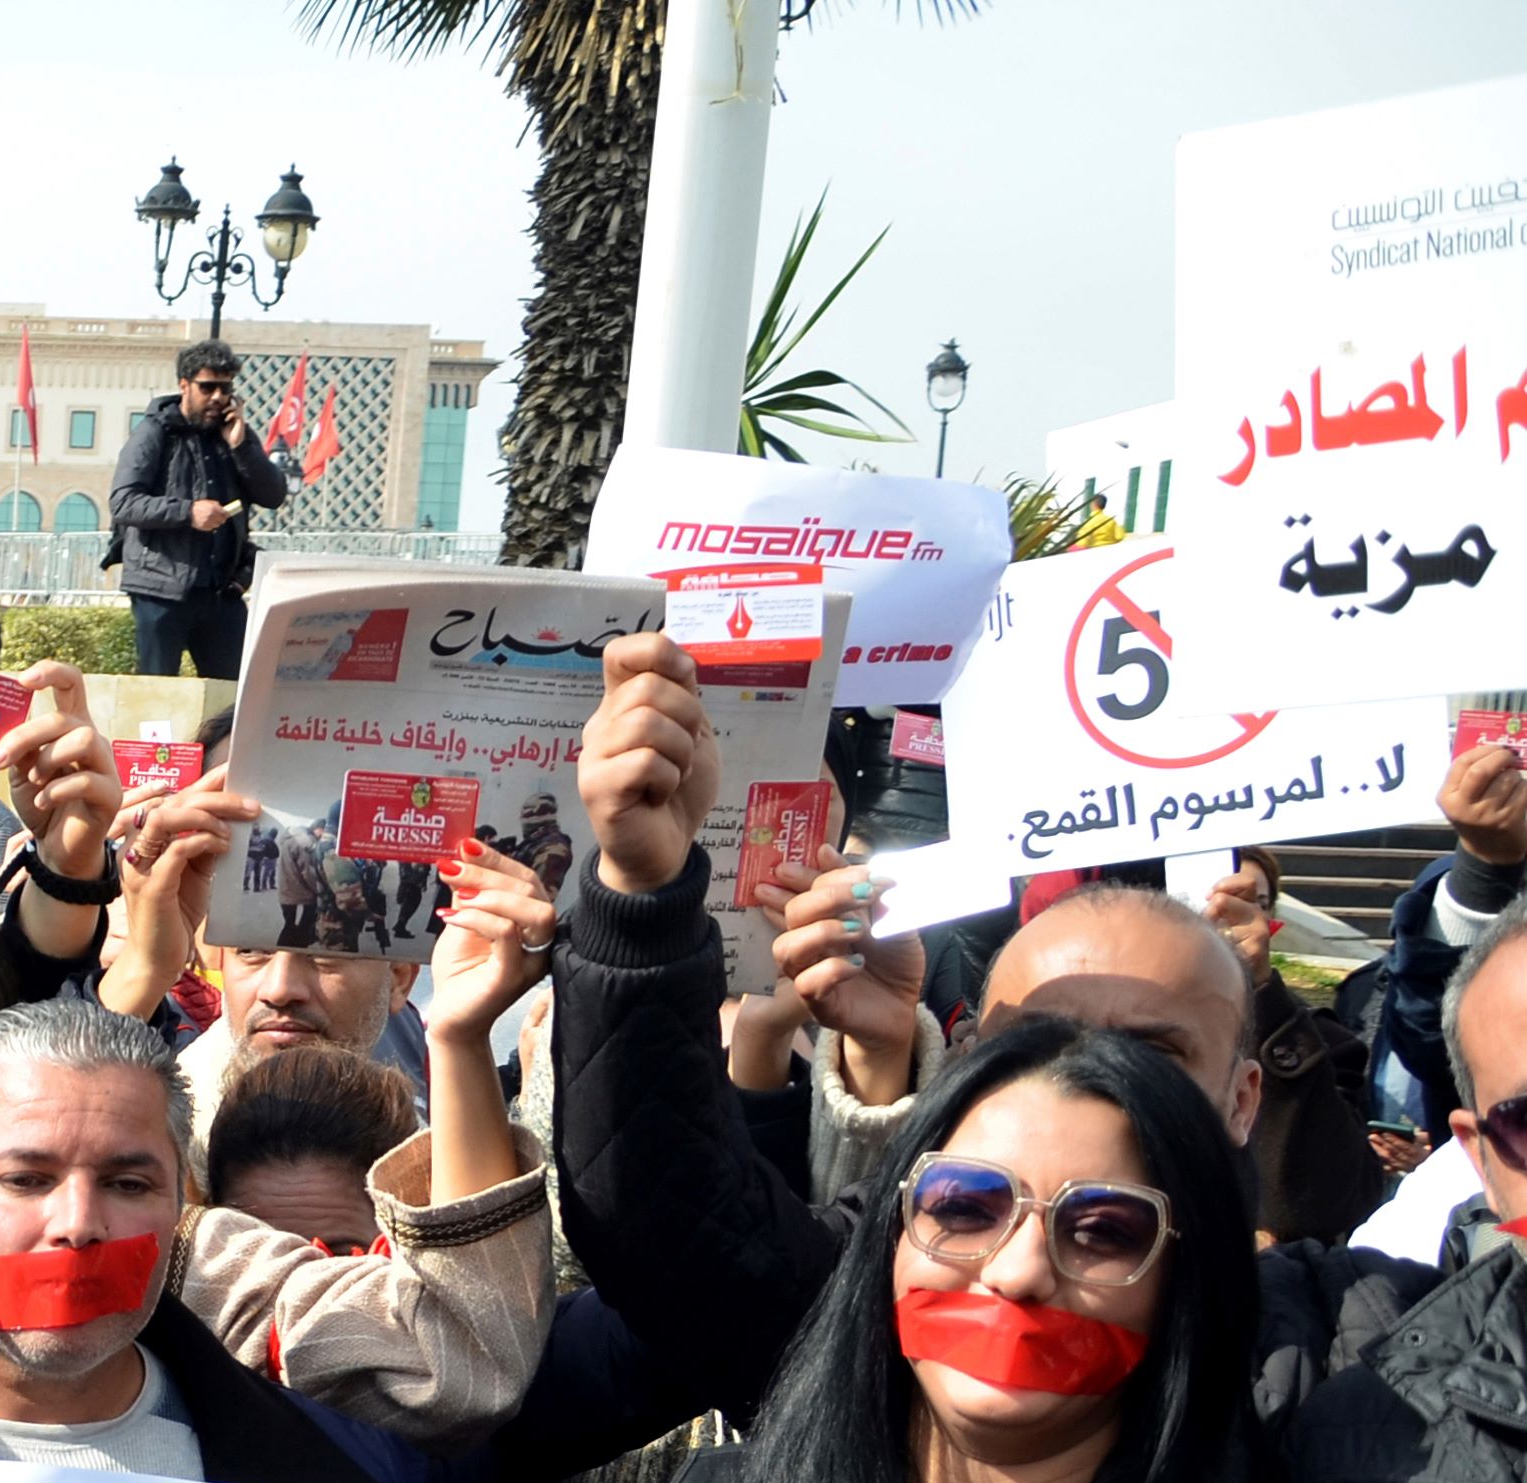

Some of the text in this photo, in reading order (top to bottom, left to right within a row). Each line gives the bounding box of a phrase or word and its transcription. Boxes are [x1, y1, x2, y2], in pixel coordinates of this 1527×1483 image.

[1330, 236, 1420, 280] Syndicat
[1426, 217, 1514, 262] National
[1216, 342, 1470, 487] المصادر
[656, 517, 944, 564] mosaïque fm
[1279, 512, 1499, 621] مزية
[867, 642, 954, 664] crime
[1096, 609, 1170, 721] 5
[274, 715, 328, 742] نائمة
[332, 718, 384, 751] خلية
[372, 806, 446, 829] صحافة
[1150, 754, 1325, 842] لمرسوم
[371, 825, 444, 846] PRESSE
[789, 810, 810, 867] RESSE
